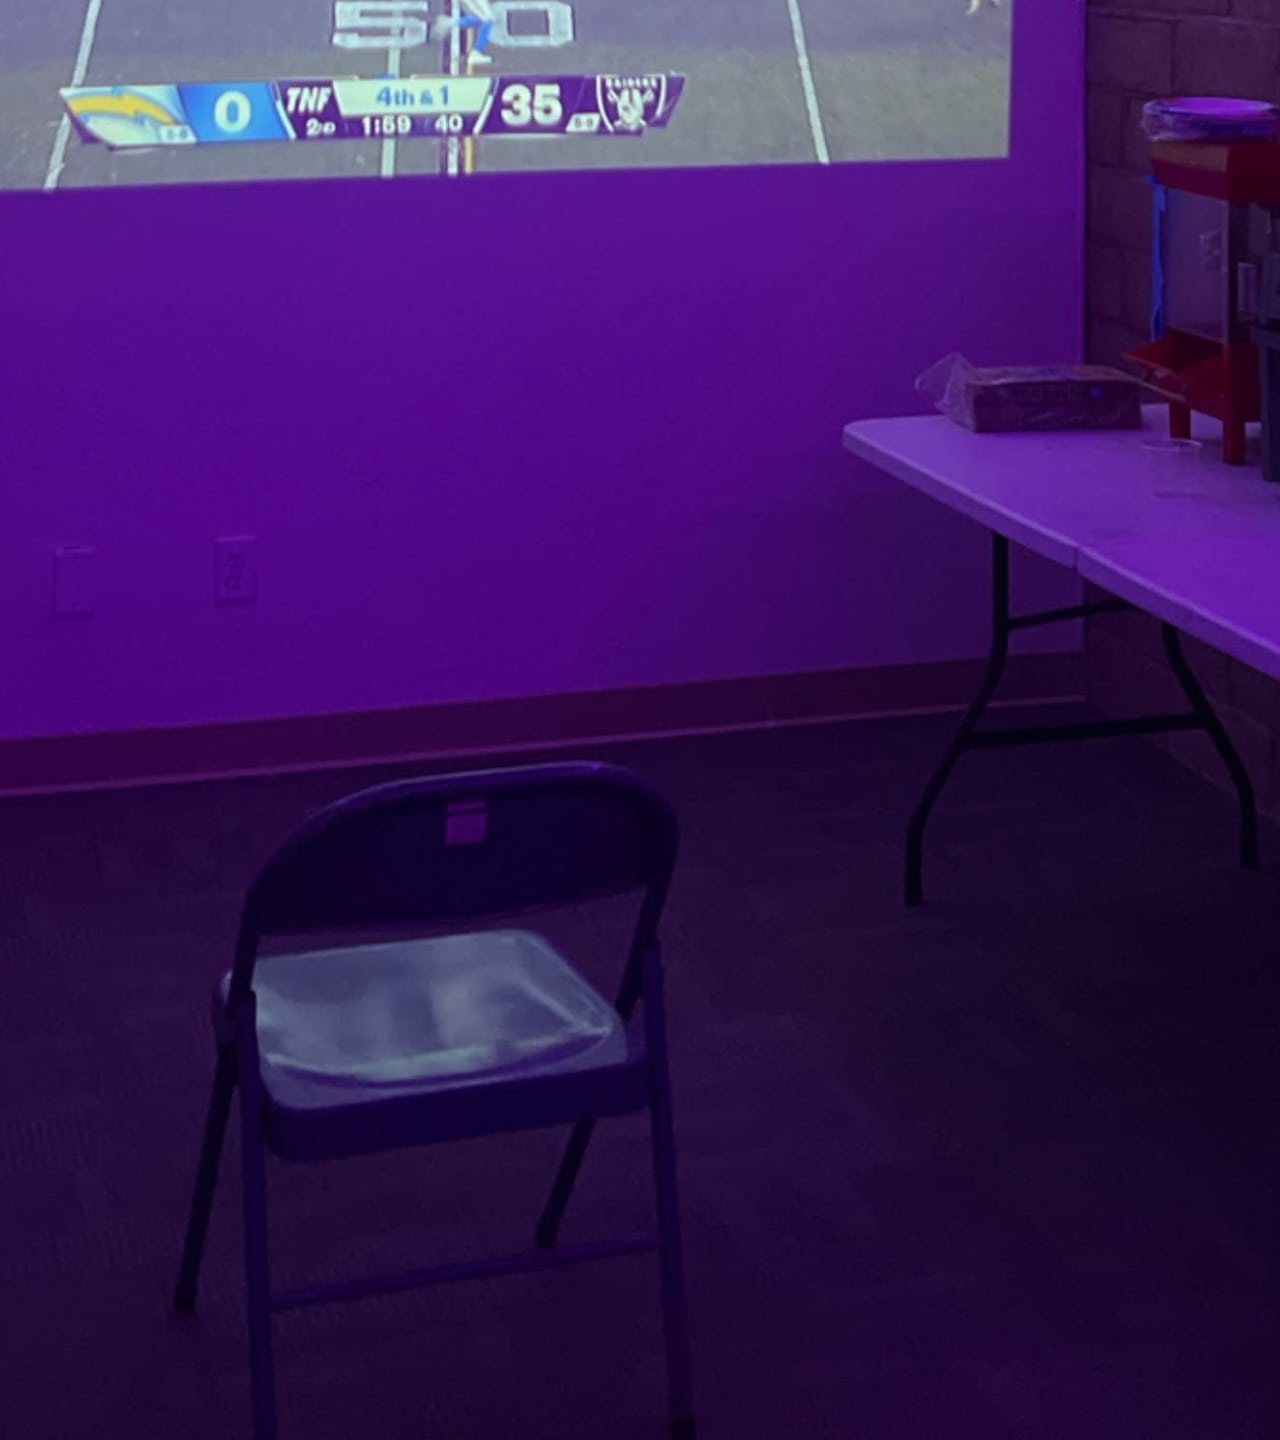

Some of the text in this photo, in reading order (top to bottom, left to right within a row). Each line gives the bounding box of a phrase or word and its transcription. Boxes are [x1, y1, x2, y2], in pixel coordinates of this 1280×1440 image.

[287, 87, 332, 113] TNF
[375, 85, 450, 106] 4th & 1
[501, 83, 563, 127] 35
[214, 91, 252, 133] 0
[434, 114, 464, 133] 40
